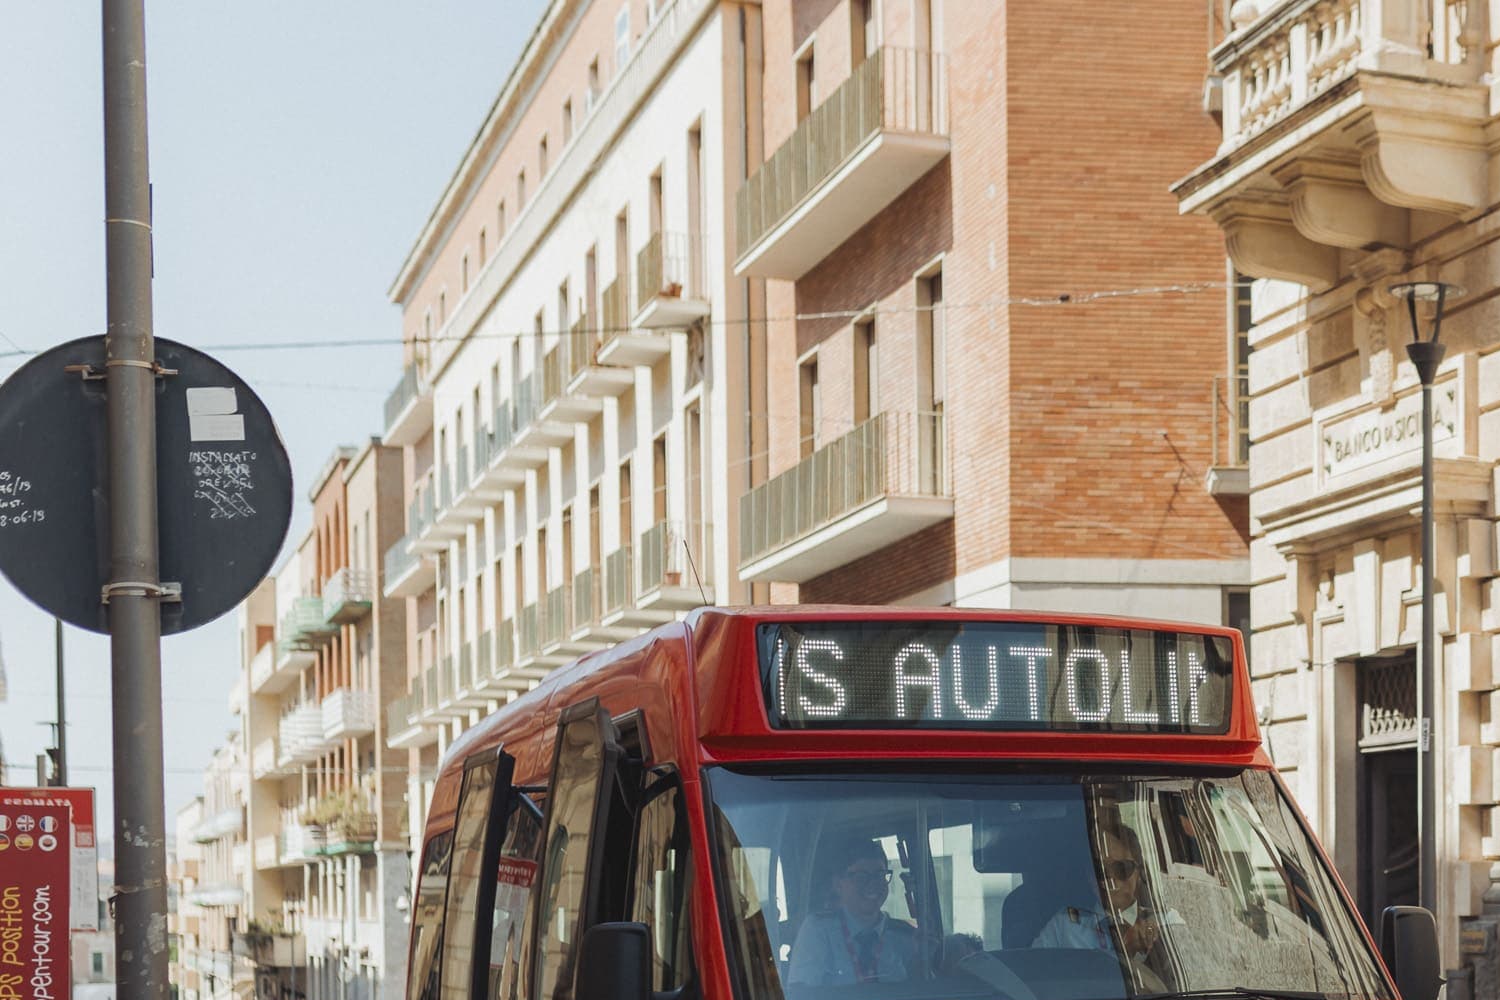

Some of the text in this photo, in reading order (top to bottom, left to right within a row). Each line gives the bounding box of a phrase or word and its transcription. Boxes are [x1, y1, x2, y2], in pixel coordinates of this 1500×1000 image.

[1335, 427, 1382, 463] BANCO
[1394, 405, 1445, 442] SICIA
[0, 886, 25, 966] position
